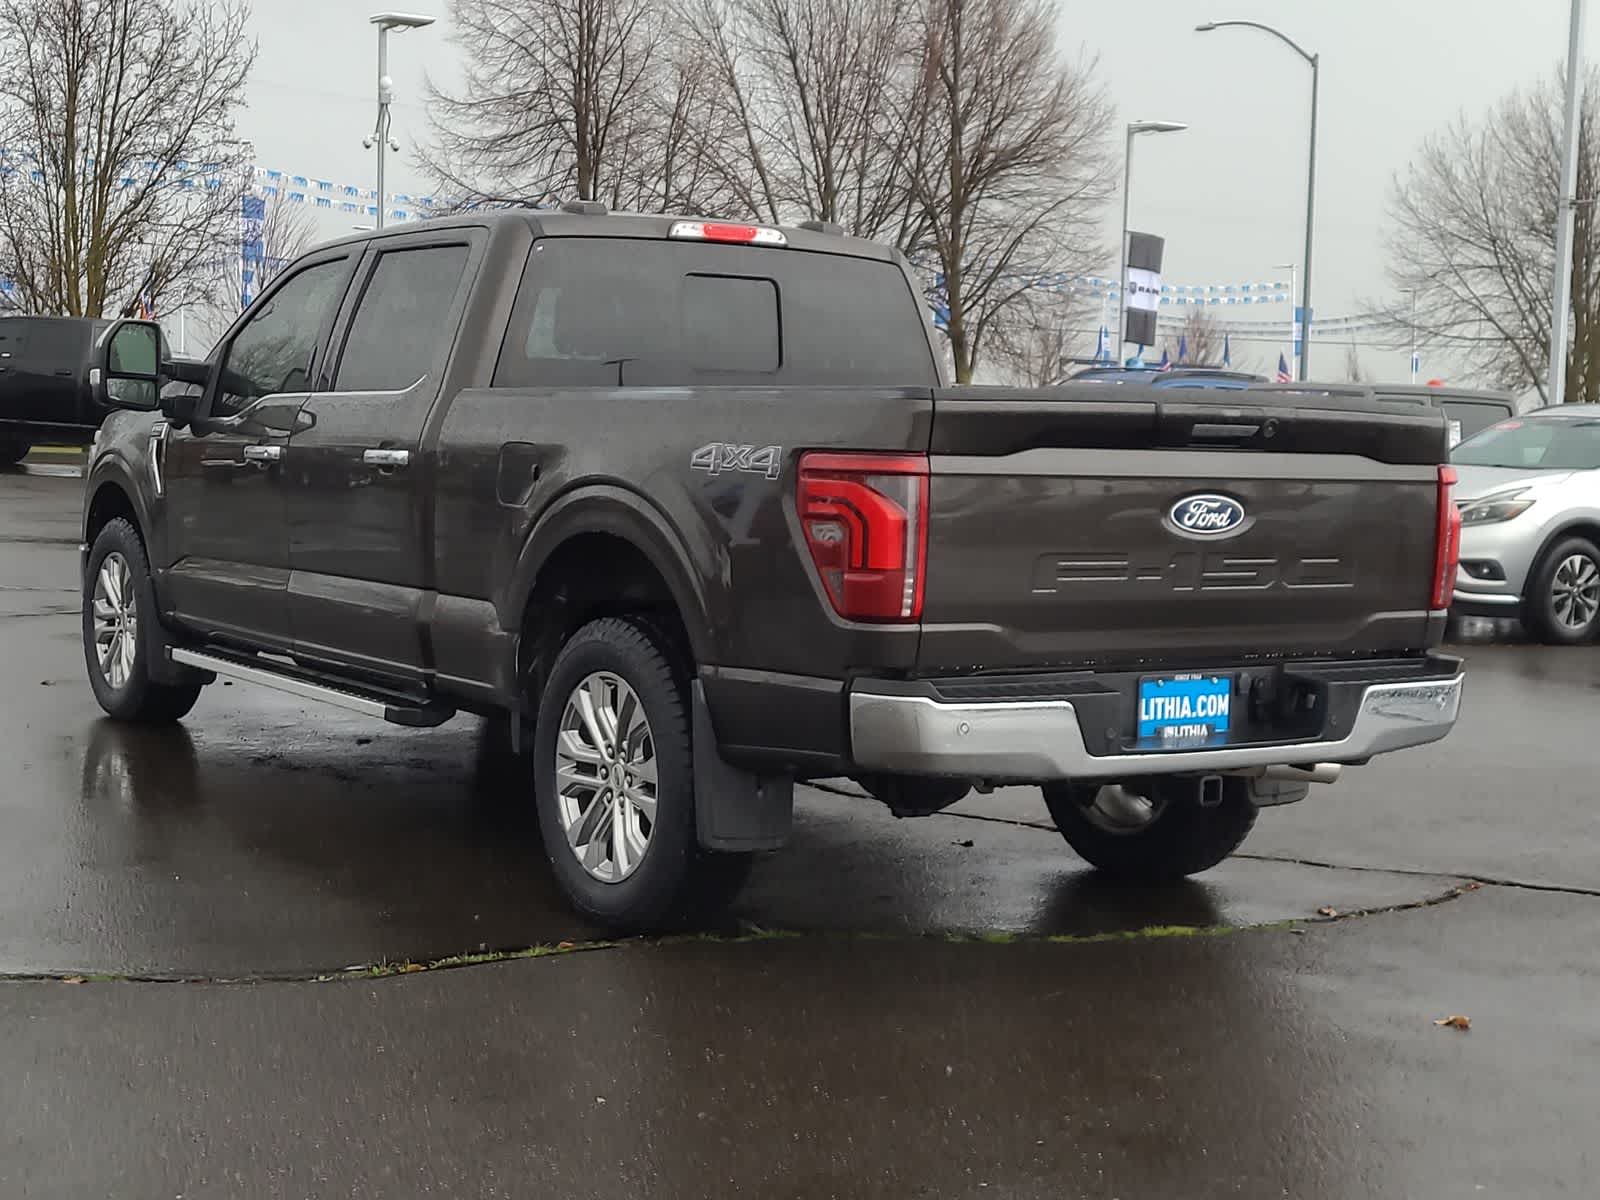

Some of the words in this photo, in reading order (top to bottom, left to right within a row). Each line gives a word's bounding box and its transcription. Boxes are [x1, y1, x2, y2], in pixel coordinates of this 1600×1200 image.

[1184, 501, 1232, 527] Ford
[1031, 552, 1356, 593] F-150
[1141, 694, 1229, 720] LITHIA.COM
